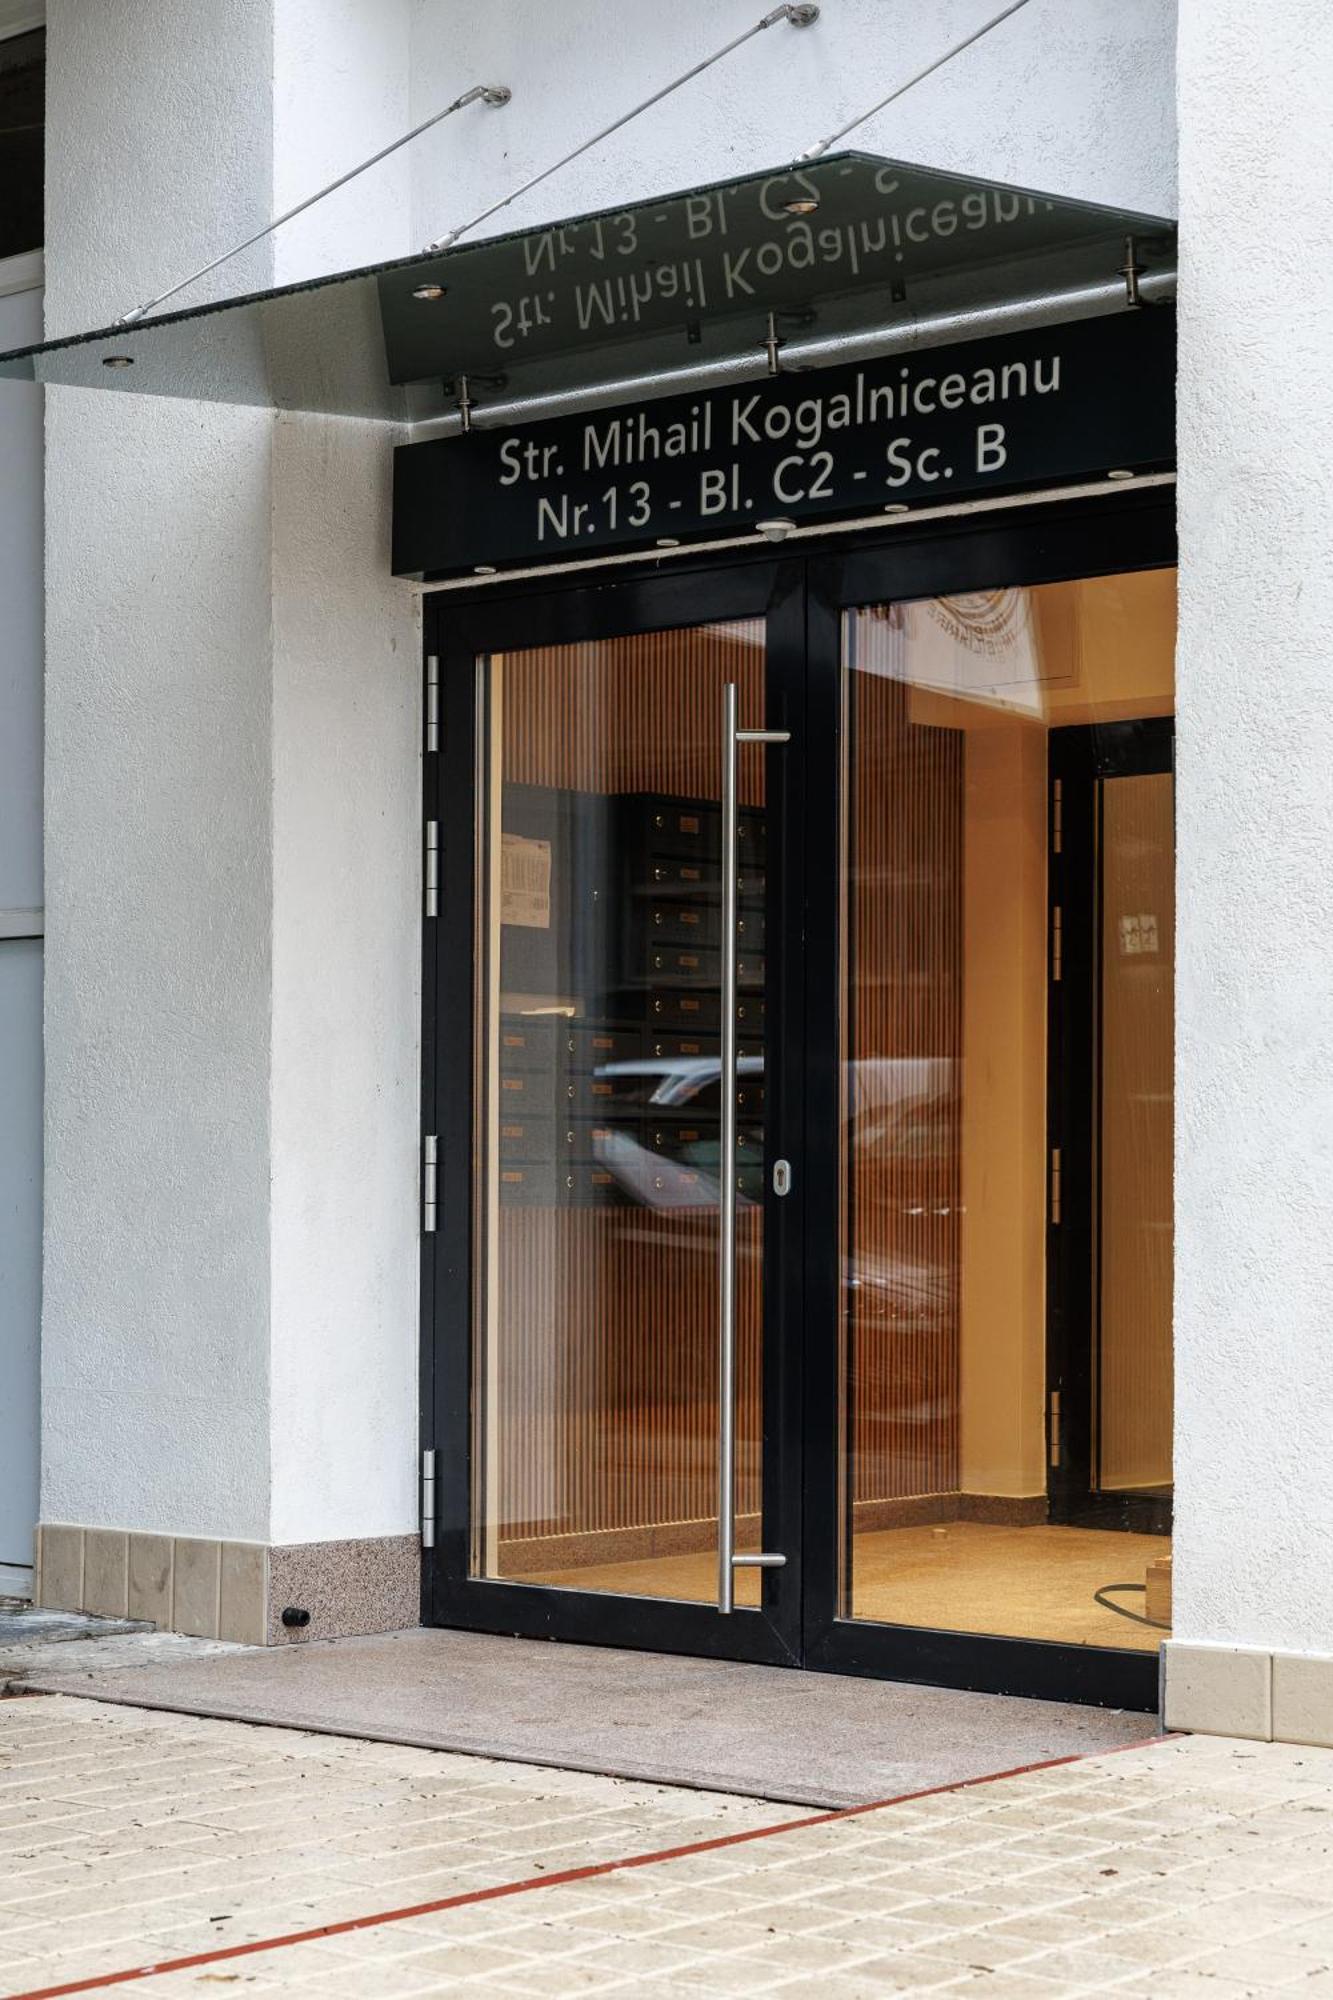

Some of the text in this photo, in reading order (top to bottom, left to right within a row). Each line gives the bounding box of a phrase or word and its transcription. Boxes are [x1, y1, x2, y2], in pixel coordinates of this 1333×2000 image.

[499, 356, 1060, 486] Str. Mihail Kogalniceanu
[537, 481, 651, 541] Nr.13
[700, 463, 753, 516] Bl.
[773, 451, 834, 504] C2
[885, 437, 953, 487] Sc.
[976, 423, 1007, 473] B
